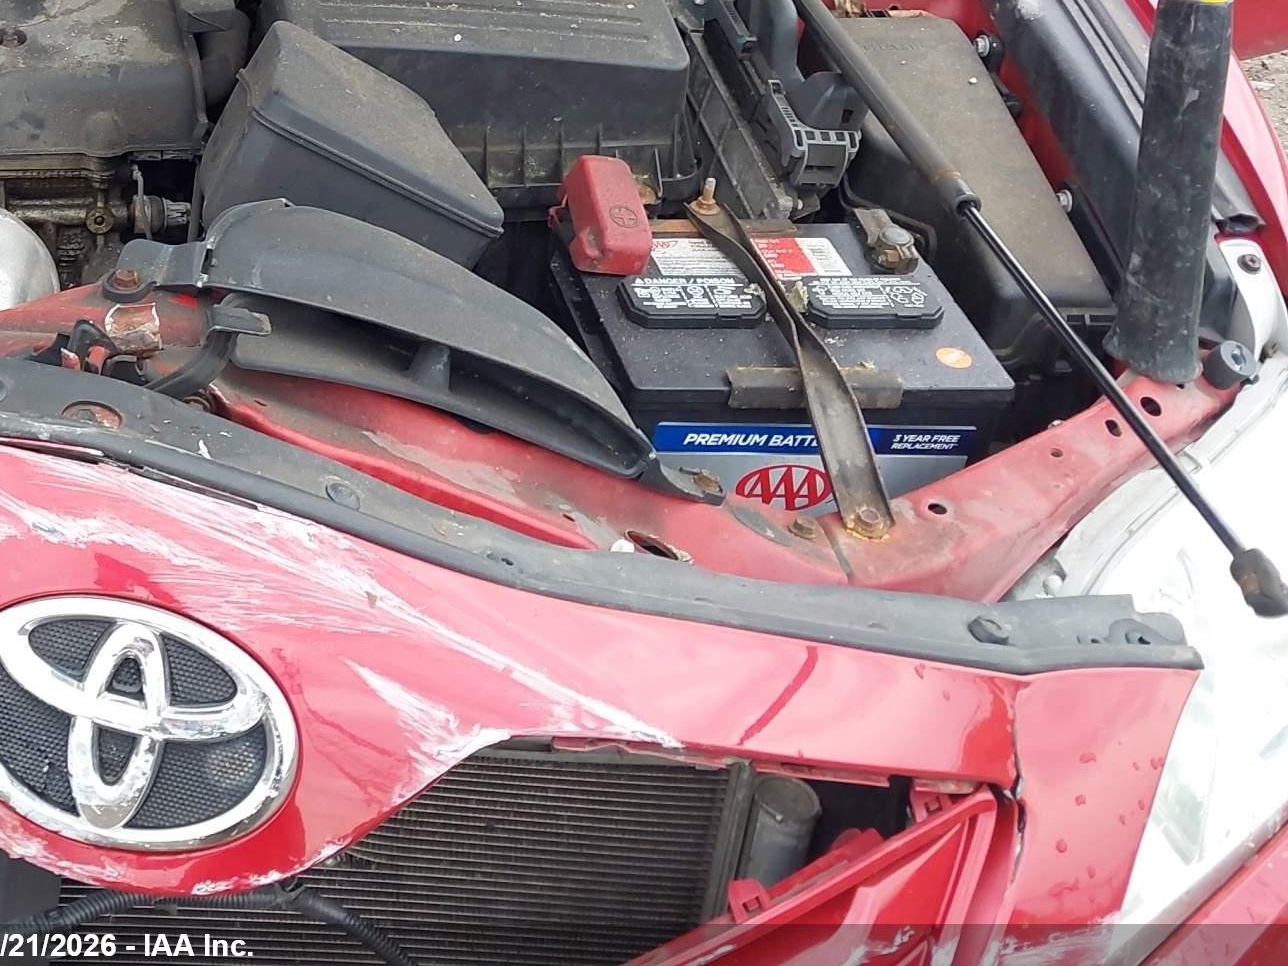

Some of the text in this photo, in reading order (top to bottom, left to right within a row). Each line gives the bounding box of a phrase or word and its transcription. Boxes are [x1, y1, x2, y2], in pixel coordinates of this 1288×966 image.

[683, 433, 768, 446] PREMIUM
[893, 434, 961, 443] 3 YEAR FREE
[735, 464, 833, 511] AAA
